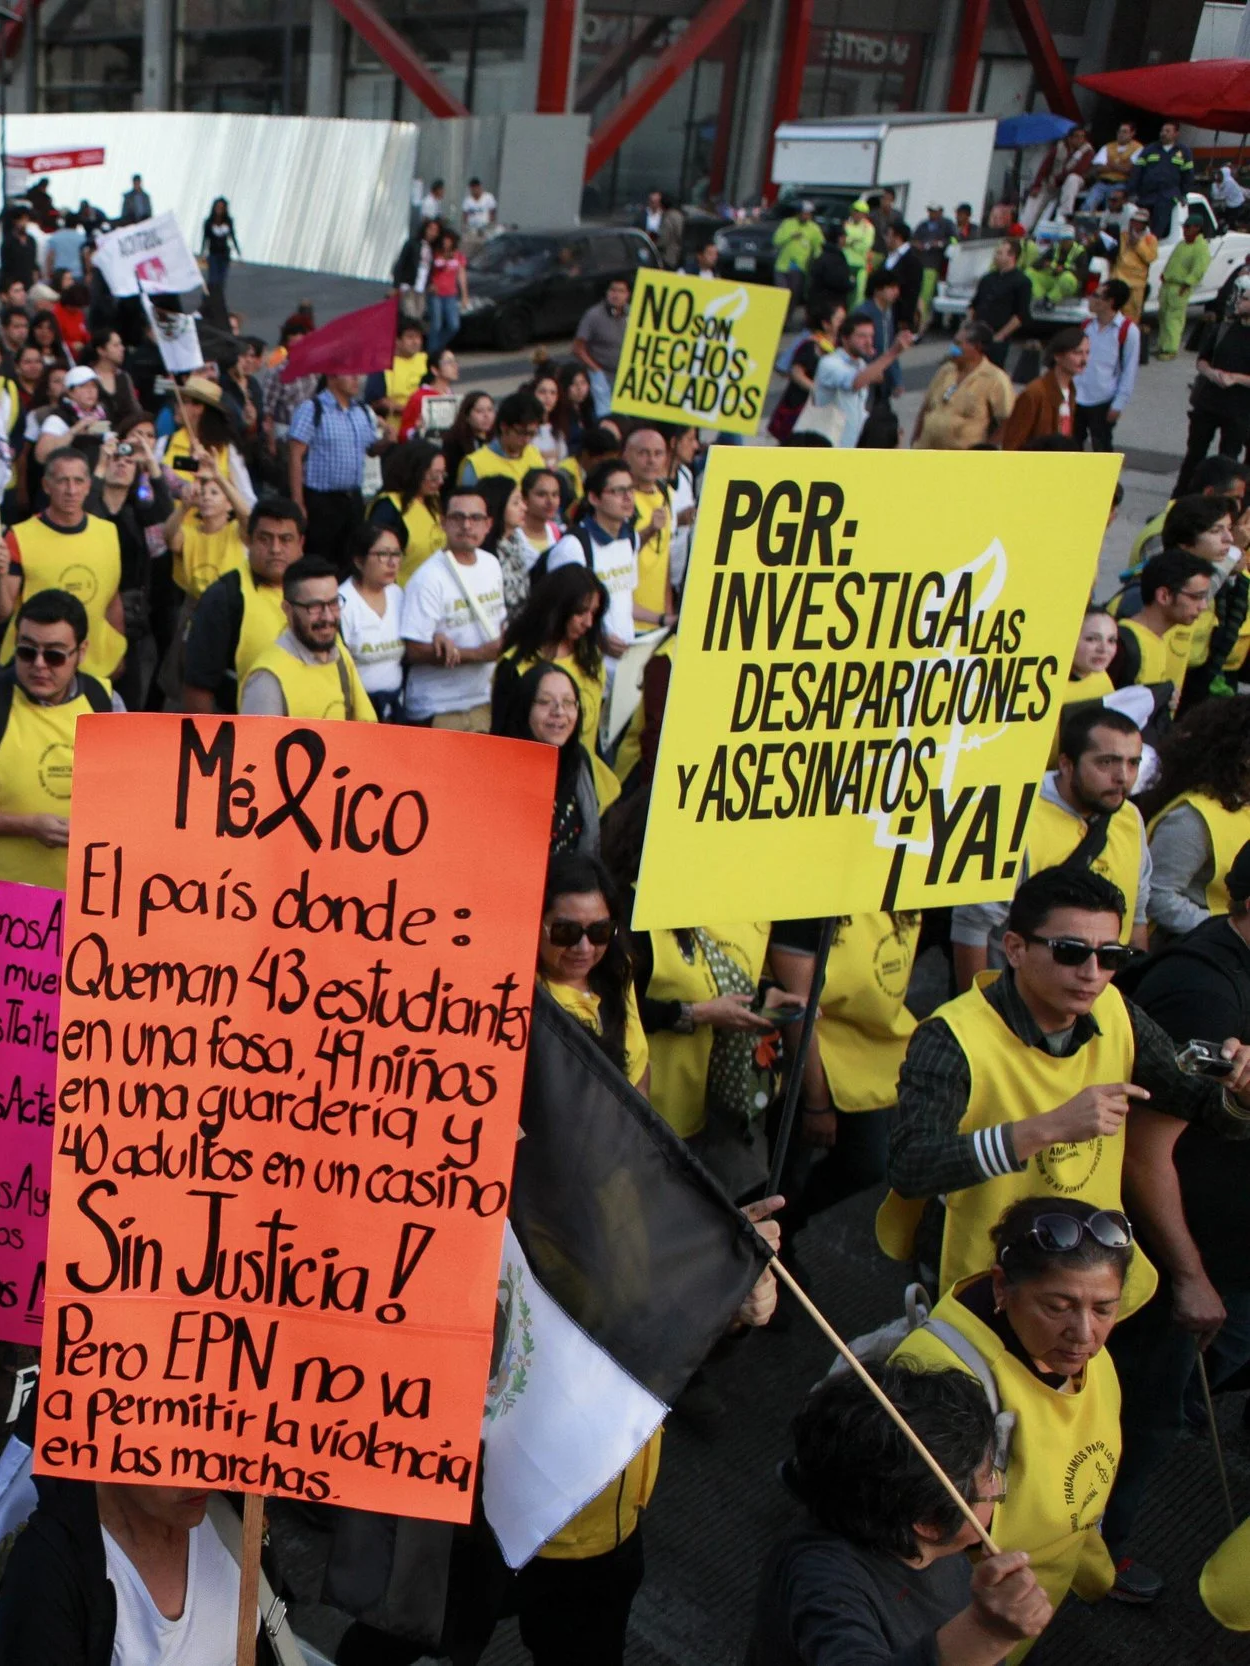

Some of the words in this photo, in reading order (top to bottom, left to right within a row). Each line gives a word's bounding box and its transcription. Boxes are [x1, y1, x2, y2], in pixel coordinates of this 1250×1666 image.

[637, 283, 695, 335] NO
[690, 315, 734, 342] SON
[617, 366, 762, 420] AISLADOS
[630, 332, 749, 382] HECHOS
[713, 479, 858, 567] PGR:
[701, 570, 973, 653] INVESTIGA
[969, 608, 1025, 656] LAS
[730, 655, 1058, 733] DESAPARICIONES
[676, 763, 700, 810] Y
[695, 737, 937, 823] ASESINATOS
[80, 842, 123, 919] El
[137, 868, 258, 937] país
[879, 782, 1037, 912] ¡YA!
[4, 963, 61, 997] mue
[65, 931, 240, 1008] Queman
[246, 945, 310, 1015] 43
[313, 957, 530, 1052] estudiantes
[60, 1018, 114, 1064] en
[122, 1020, 198, 1068] una
[206, 1014, 306, 1082] fosa,
[314, 1026, 365, 1091] 49
[368, 1043, 498, 1107] niños
[58, 1074, 110, 1114] en
[117, 1079, 190, 1122] una
[196, 1078, 418, 1149] guardería
[441, 1112, 484, 1170] y
[58, 1122, 110, 1177] 40
[111, 1128, 254, 1183] adultos
[261, 1149, 305, 1189] en
[313, 1157, 359, 1200] un
[364, 1155, 508, 1219] casino
[65, 1179, 164, 1295] Sin
[55, 1301, 149, 1381] Pero
[161, 1310, 280, 1393] EPN
[291, 1356, 366, 1403] no
[380, 1371, 432, 1420] va
[40, 1434, 99, 1470] en
[109, 1432, 162, 1476] las
[42, 1387, 72, 1422] a
[86, 1386, 257, 1442] permitir
[263, 1400, 300, 1449] la
[309, 1417, 473, 1492] violencia
[1063, 1449, 1088, 1506] TRABAJAMOS
